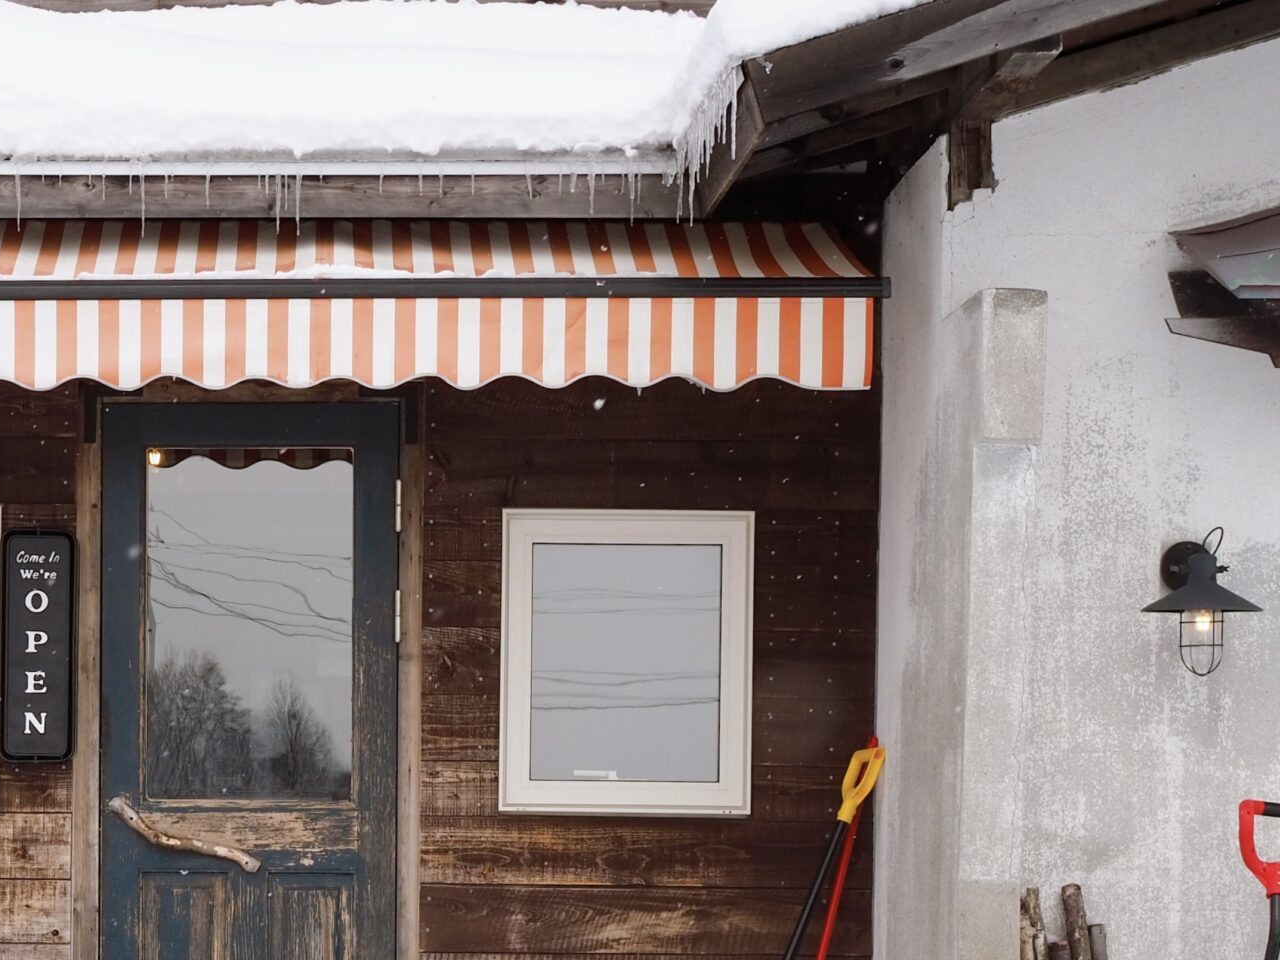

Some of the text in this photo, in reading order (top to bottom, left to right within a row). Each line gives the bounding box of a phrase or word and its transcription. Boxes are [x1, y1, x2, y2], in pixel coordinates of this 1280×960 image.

[16, 550, 60, 563] Come In
[20, 568, 57, 579] We're
[23, 589, 49, 734] OPEN
